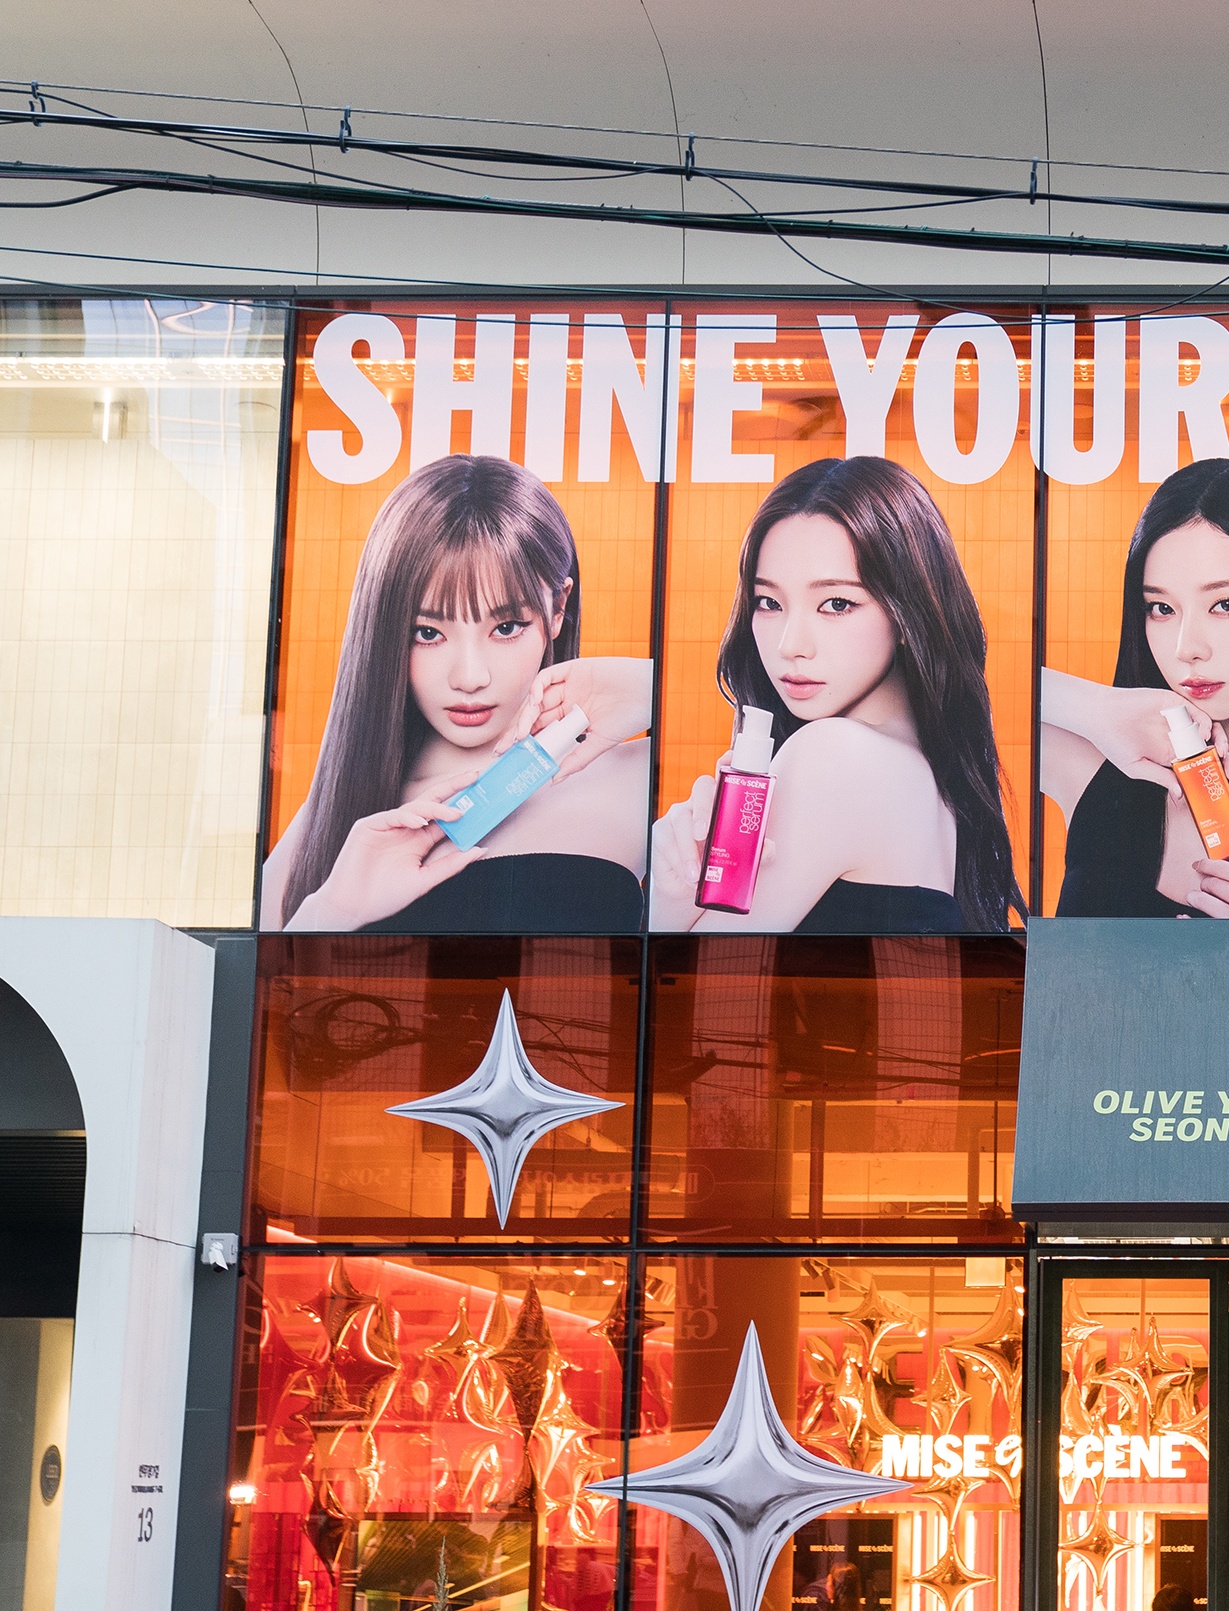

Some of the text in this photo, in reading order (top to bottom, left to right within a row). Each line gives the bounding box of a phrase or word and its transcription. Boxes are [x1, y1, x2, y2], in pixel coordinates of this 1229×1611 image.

[306, 313, 777, 485] SHINE
[506, 762, 538, 795] perfect
[513, 768, 543, 796] serum
[725, 777, 740, 785] MISE
[1198, 769, 1221, 802] perfect
[1208, 764, 1225, 795] serum
[739, 791, 756, 834] perfect
[750, 792, 765, 832] serum
[1092, 1089, 1204, 1115] OLIVE
[882, 1434, 989, 1478] MISE
[138, 1507, 153, 1542] 13
